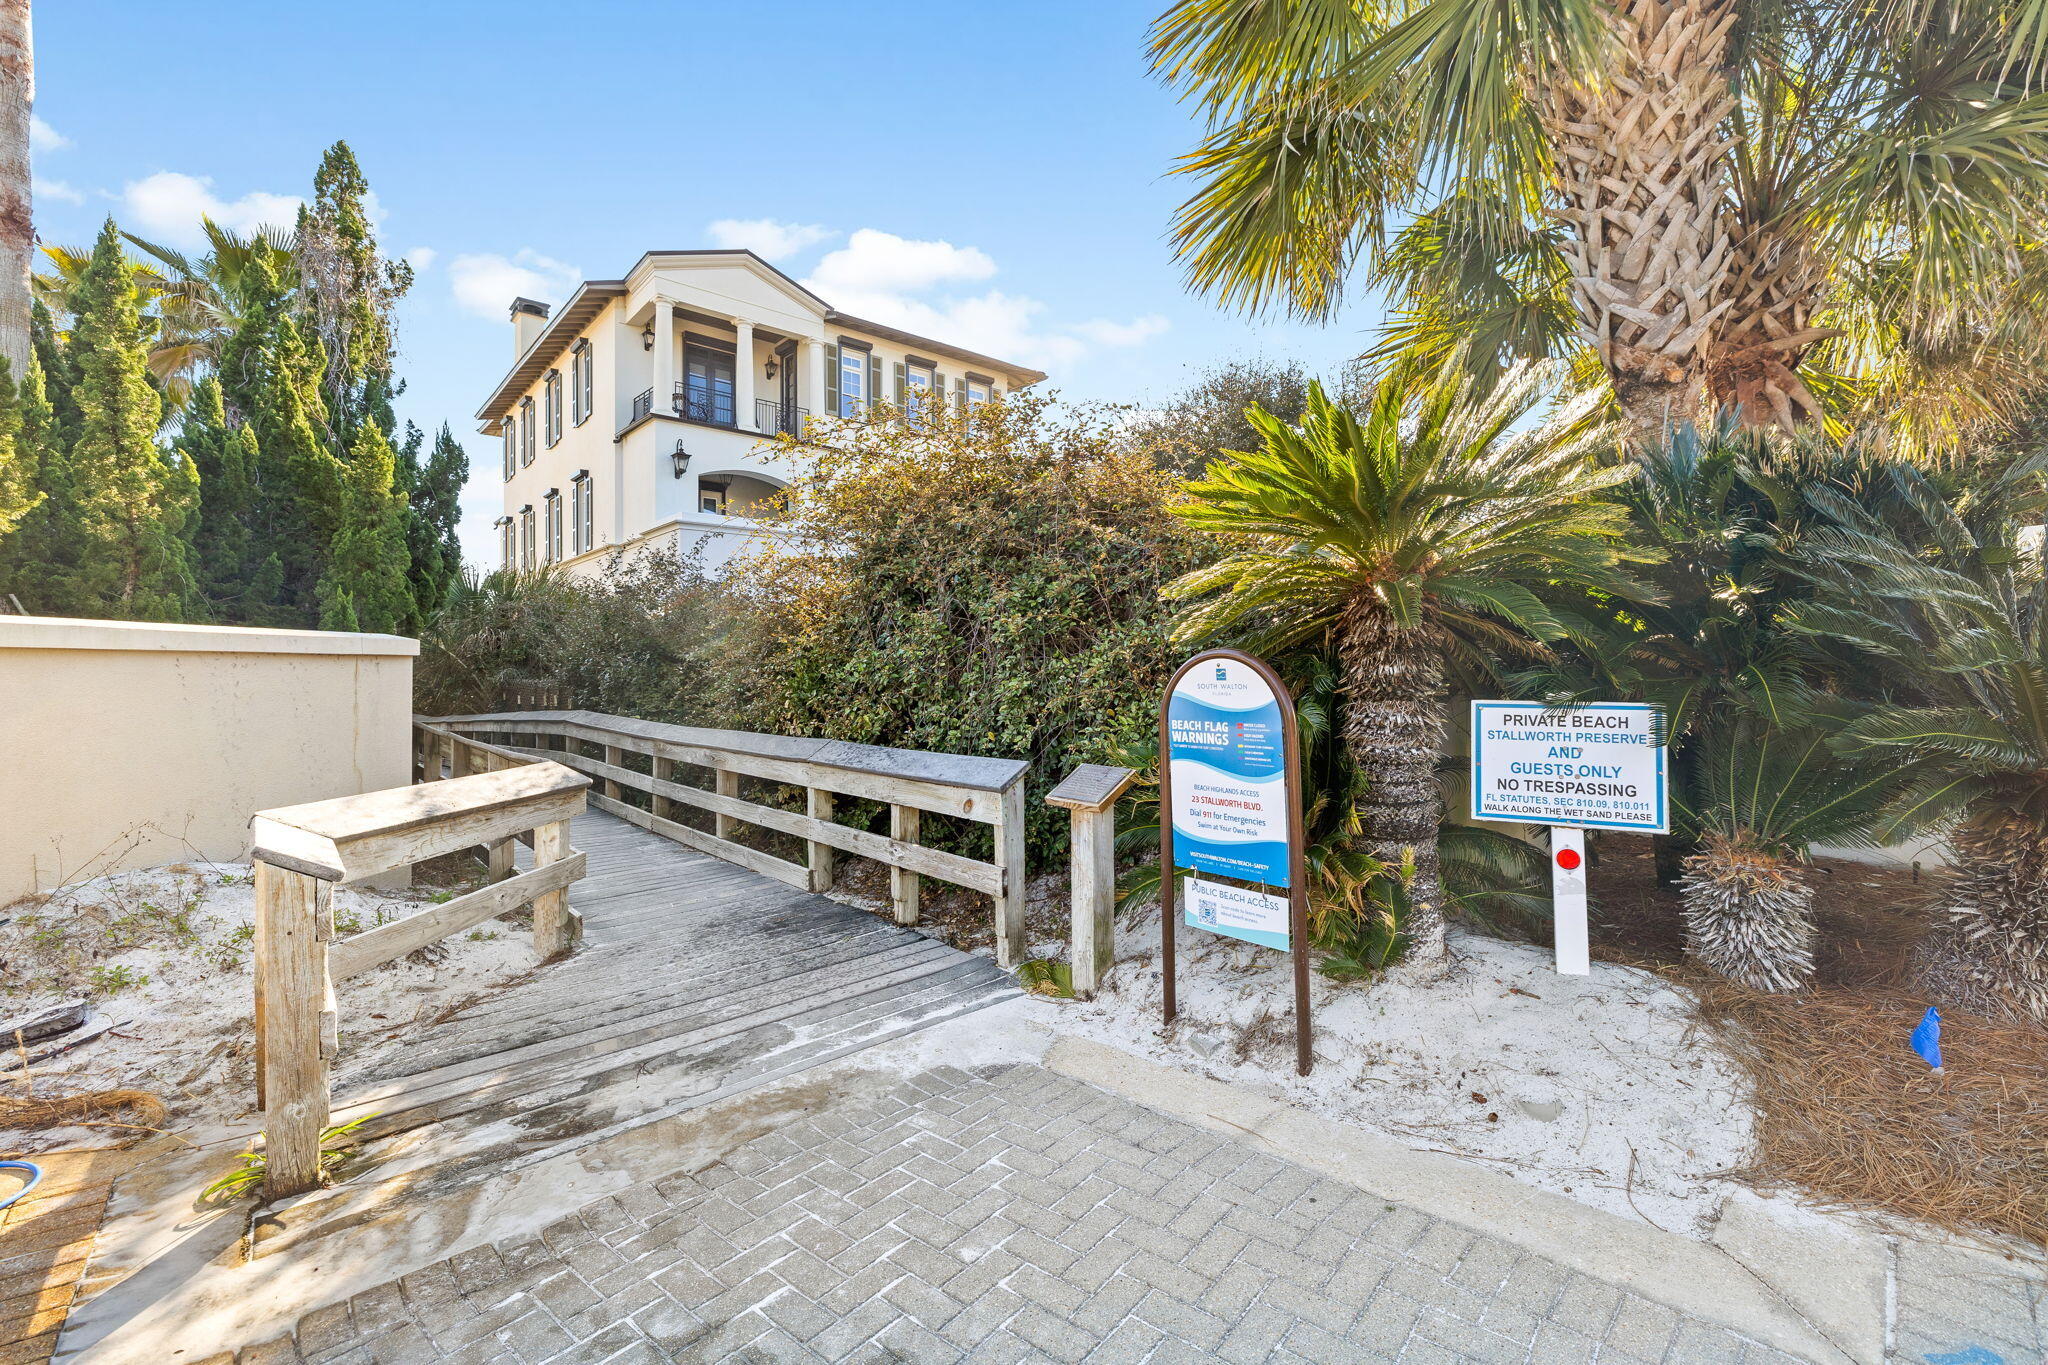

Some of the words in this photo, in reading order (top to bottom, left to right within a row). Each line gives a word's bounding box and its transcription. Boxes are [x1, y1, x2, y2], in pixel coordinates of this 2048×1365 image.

[1171, 719, 1202, 731] BEACH
[1204, 721, 1229, 733] FLAG
[1503, 714, 1566, 728] PRIVATE
[1572, 715, 1629, 729] BEACH
[1171, 730, 1230, 746] WARNINGS
[1487, 730, 1571, 742] STALLWORTH
[1576, 732, 1647, 745] PRESERVE
[1548, 746, 1582, 759] AND
[1510, 762, 1574, 776] GUESTS
[1578, 765, 1622, 779] ONLY
[1193, 784, 1210, 792] BEACH
[1210, 786, 1240, 795] HIGHLANDS
[1240, 789, 1260, 798] ACCESS
[1497, 778, 1519, 791] NO
[1524, 779, 1637, 797] TRESPASSING
[1191, 795, 1200, 803] 23
[1200, 796, 1242, 809] STALLWORTH
[1243, 801, 1264, 812] BLVD.
[1486, 793, 1497, 802] FL
[1499, 794, 1551, 805] STATUTES,
[1554, 797, 1574, 806] SEC
[1576, 798, 1610, 809] 810.09,
[1613, 800, 1649, 811] 810.011
[1189, 808, 1202, 817] Dial
[1202, 810, 1212, 819] 911
[1213, 811, 1222, 820] for
[1223, 813, 1267, 827] Emergencies
[1484, 803, 1509, 812] WALK
[1510, 804, 1542, 814] ALONG
[1544, 807, 1562, 815] THE
[1563, 808, 1584, 817] WET
[1586, 810, 1612, 819] SAND
[1614, 811, 1652, 822] PLEASE
[1197, 821, 1212, 829] Swim
[1219, 824, 1232, 833] Your
[1233, 826, 1246, 835] Own
[1246, 828, 1258, 836] Risk
[1191, 883, 1218, 897] PUBLIC
[1219, 890, 1246, 905] BEACH
[1247, 897, 1280, 912] ACCESS
